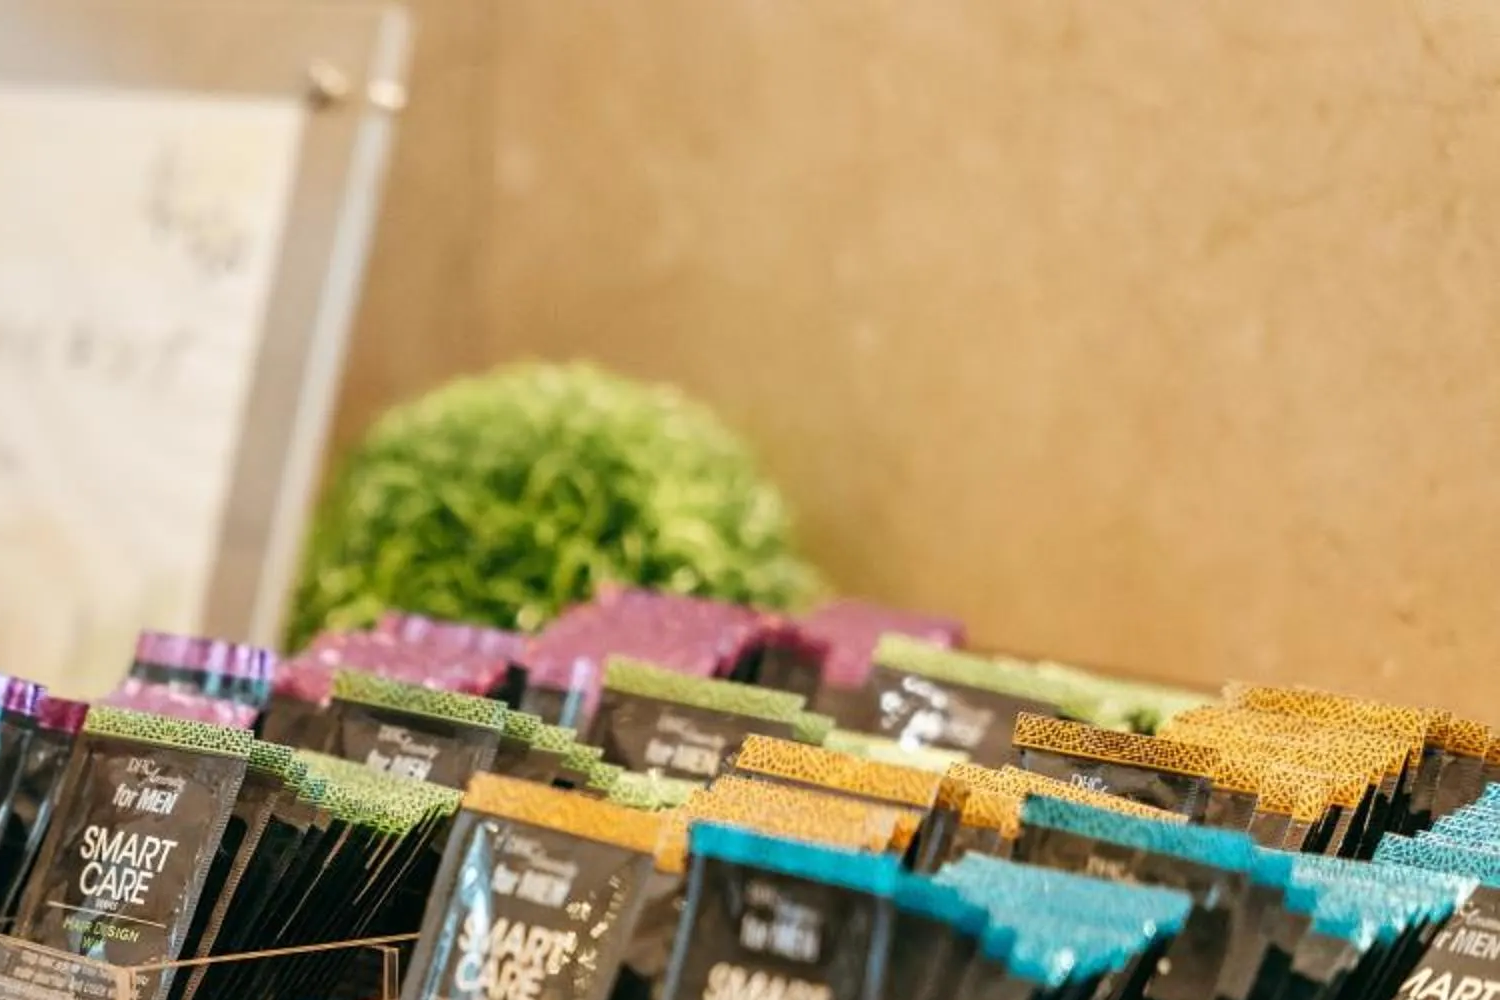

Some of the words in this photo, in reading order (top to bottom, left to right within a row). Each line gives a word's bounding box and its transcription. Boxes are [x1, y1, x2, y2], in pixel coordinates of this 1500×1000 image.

[112, 783, 139, 808] for
[136, 787, 180, 815] MEN
[79, 825, 179, 873] SMART
[79, 861, 154, 905] CARE
